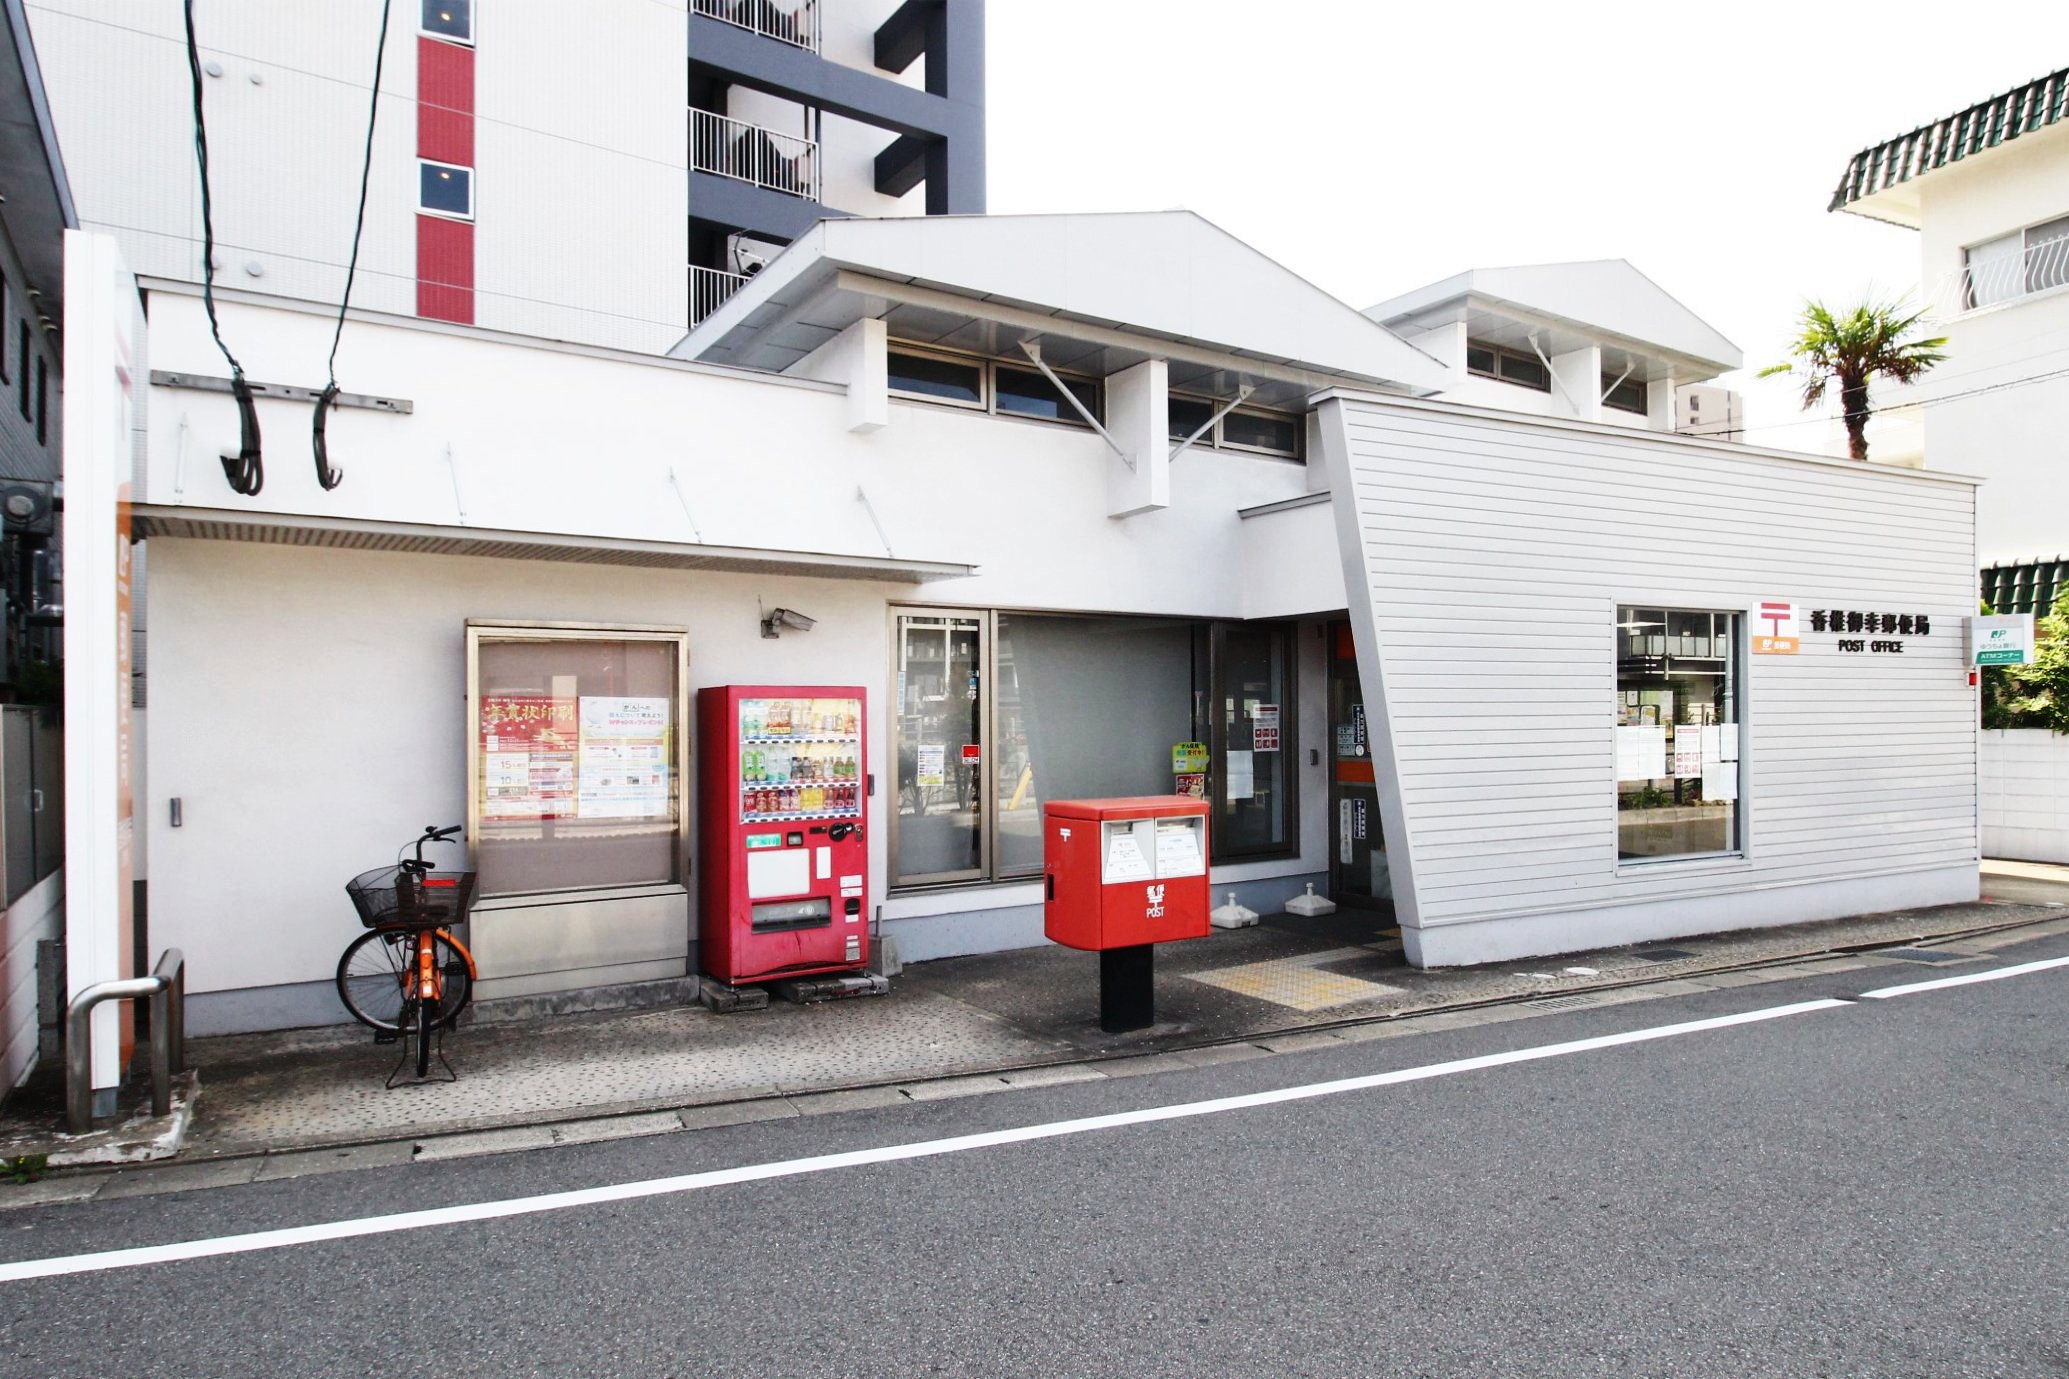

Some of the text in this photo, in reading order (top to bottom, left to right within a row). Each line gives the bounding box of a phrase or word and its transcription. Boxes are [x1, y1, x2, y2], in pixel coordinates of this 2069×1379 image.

[1838, 639, 1904, 653] POST OFFICE
[487, 703, 574, 721] 年賀状印刷
[1146, 906, 1165, 918] POST
